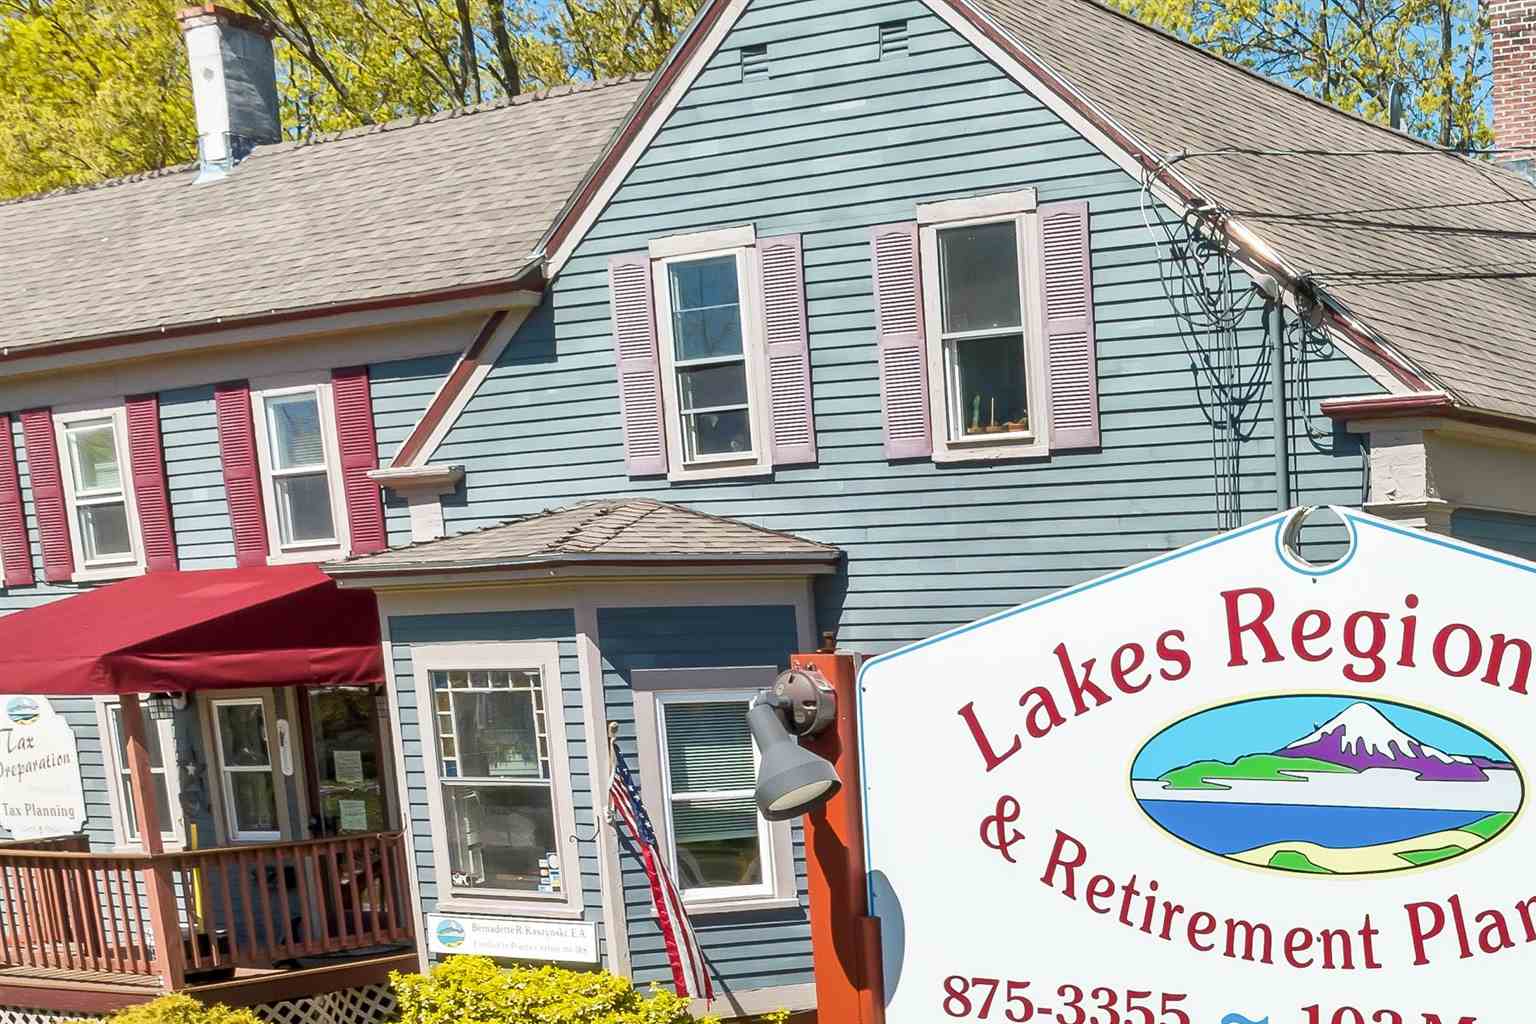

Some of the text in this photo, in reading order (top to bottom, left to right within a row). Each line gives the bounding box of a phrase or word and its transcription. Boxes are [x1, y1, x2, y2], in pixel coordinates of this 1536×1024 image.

[958, 629, 1191, 772] Lakes
[1220, 587, 1533, 695] Region
[0, 728, 35, 753] Tax
[24, 802, 75, 820] Planning
[979, 795, 1025, 863] &
[1040, 829, 1382, 970] Retirement
